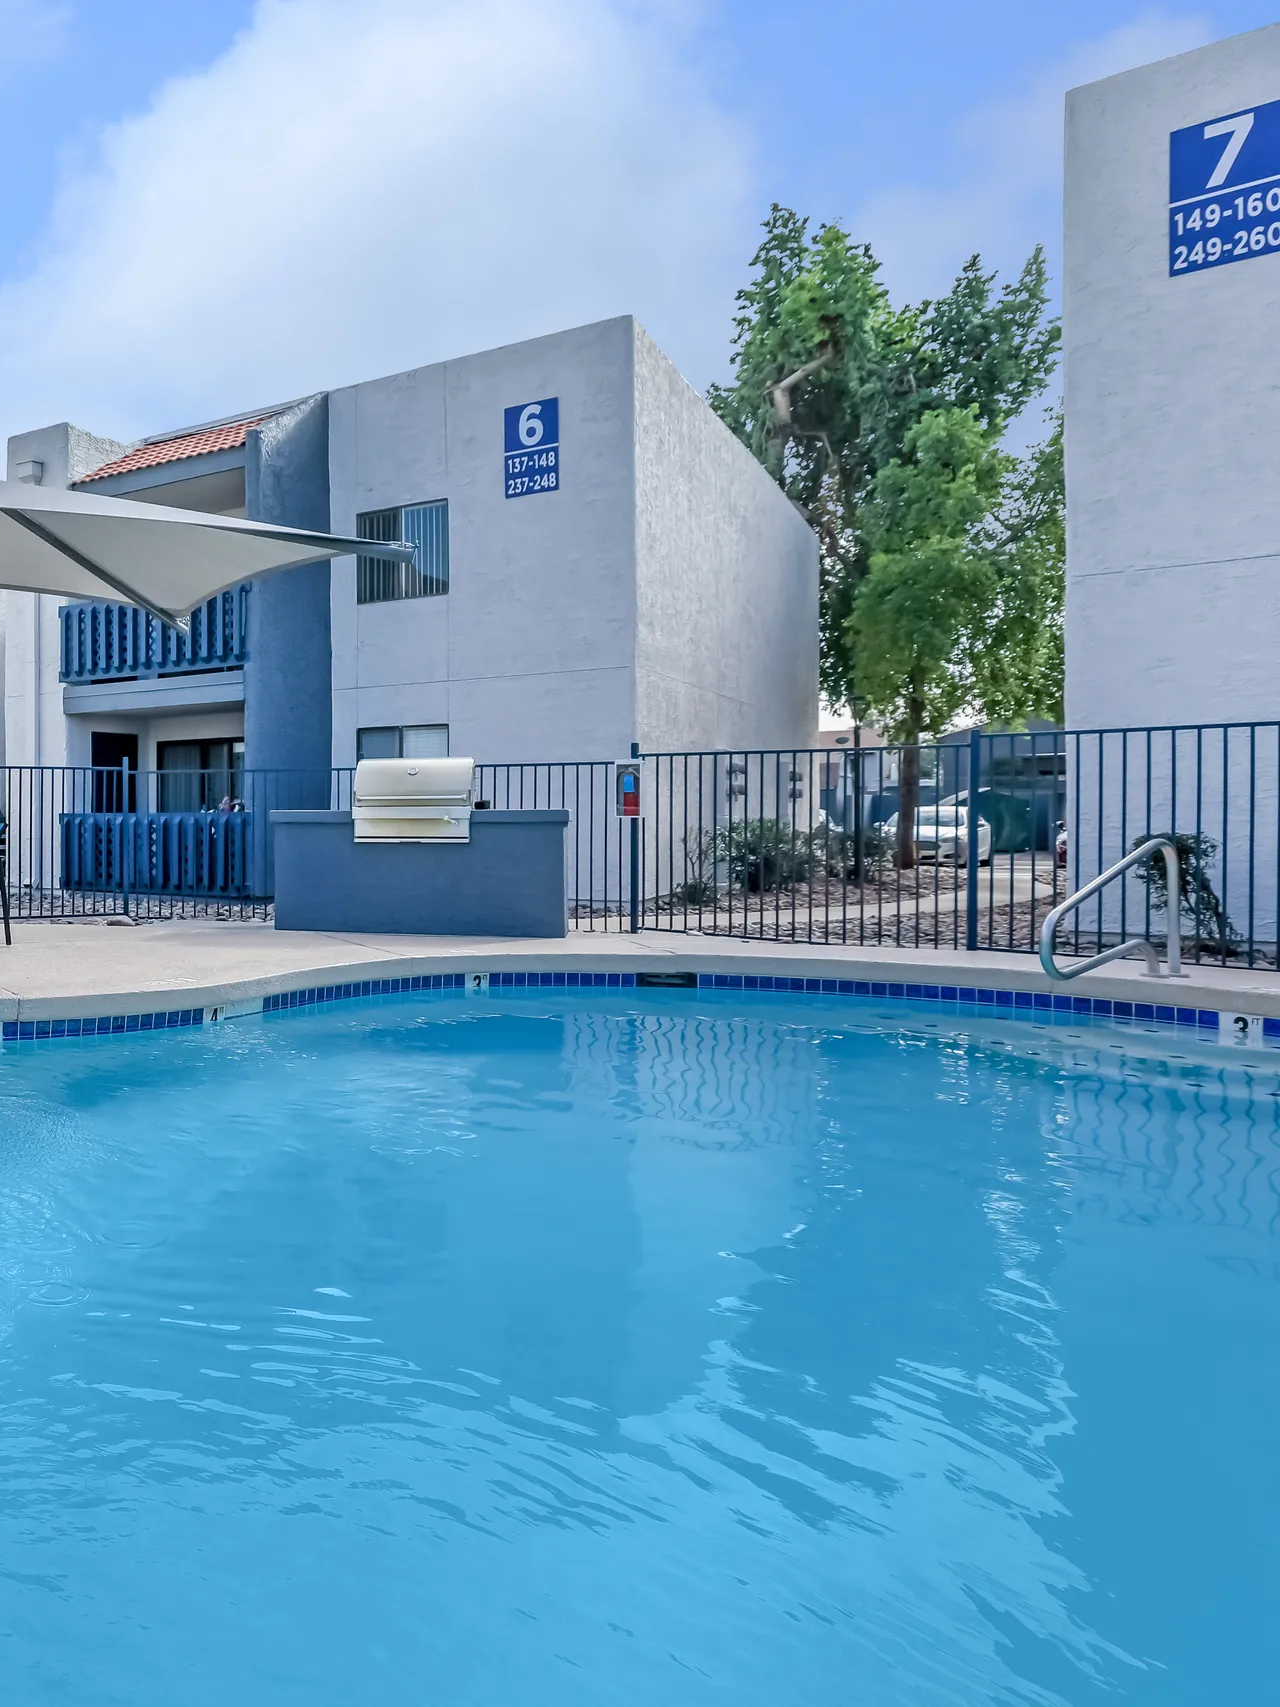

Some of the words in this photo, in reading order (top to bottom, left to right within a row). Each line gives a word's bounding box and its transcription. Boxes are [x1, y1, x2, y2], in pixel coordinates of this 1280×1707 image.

[1203, 112, 1254, 189] 7
[1174, 187, 1280, 236] 149-160
[1173, 221, 1280, 270] 249-260
[518, 404, 544, 446] 6
[507, 451, 556, 474] 137-148
[507, 472, 557, 495] 237-248
